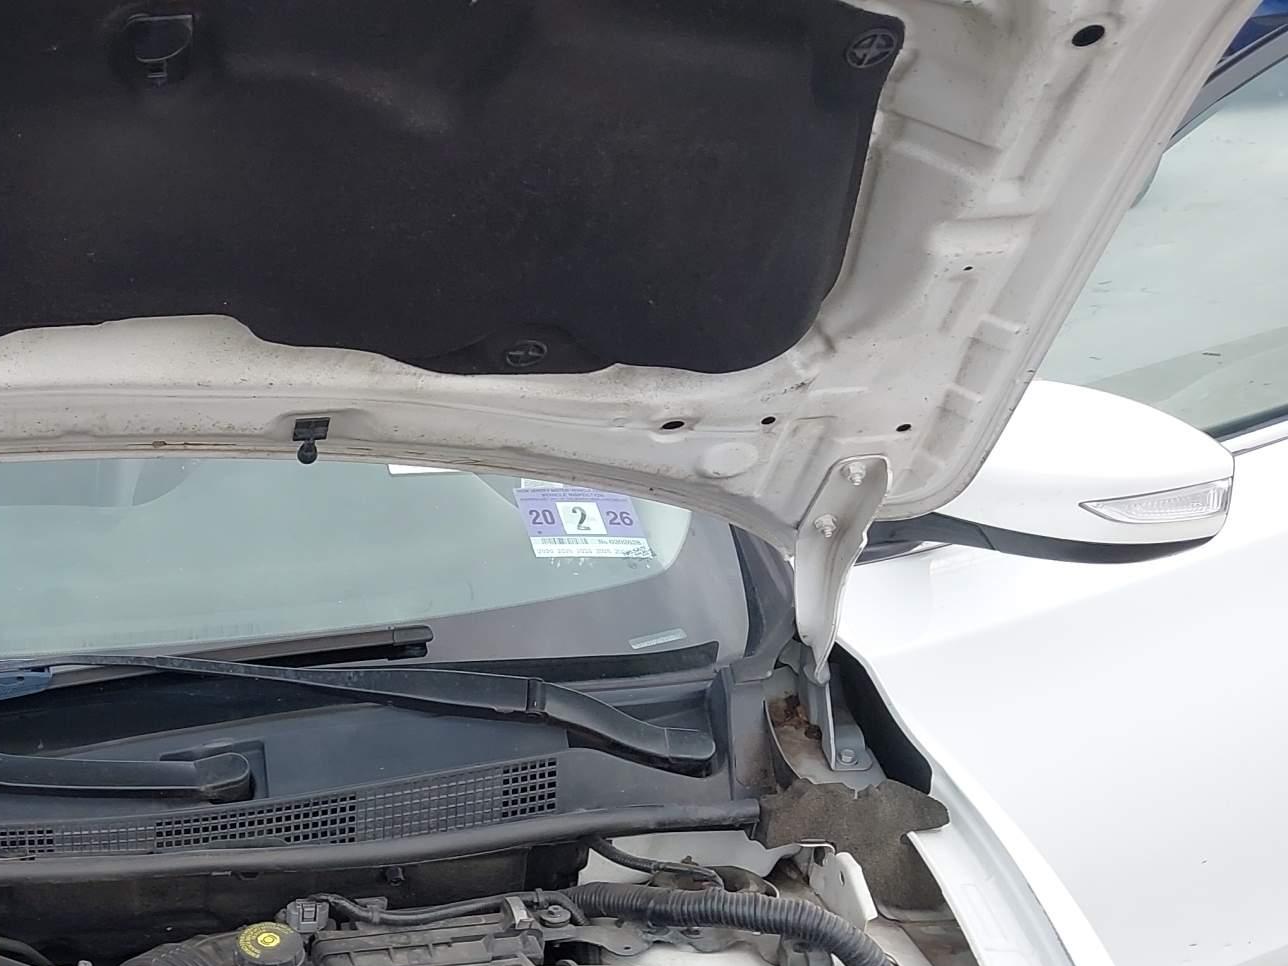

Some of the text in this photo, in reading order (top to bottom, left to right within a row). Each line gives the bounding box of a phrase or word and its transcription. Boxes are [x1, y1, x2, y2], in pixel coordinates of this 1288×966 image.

[528, 506, 634, 531] 20 2 26
